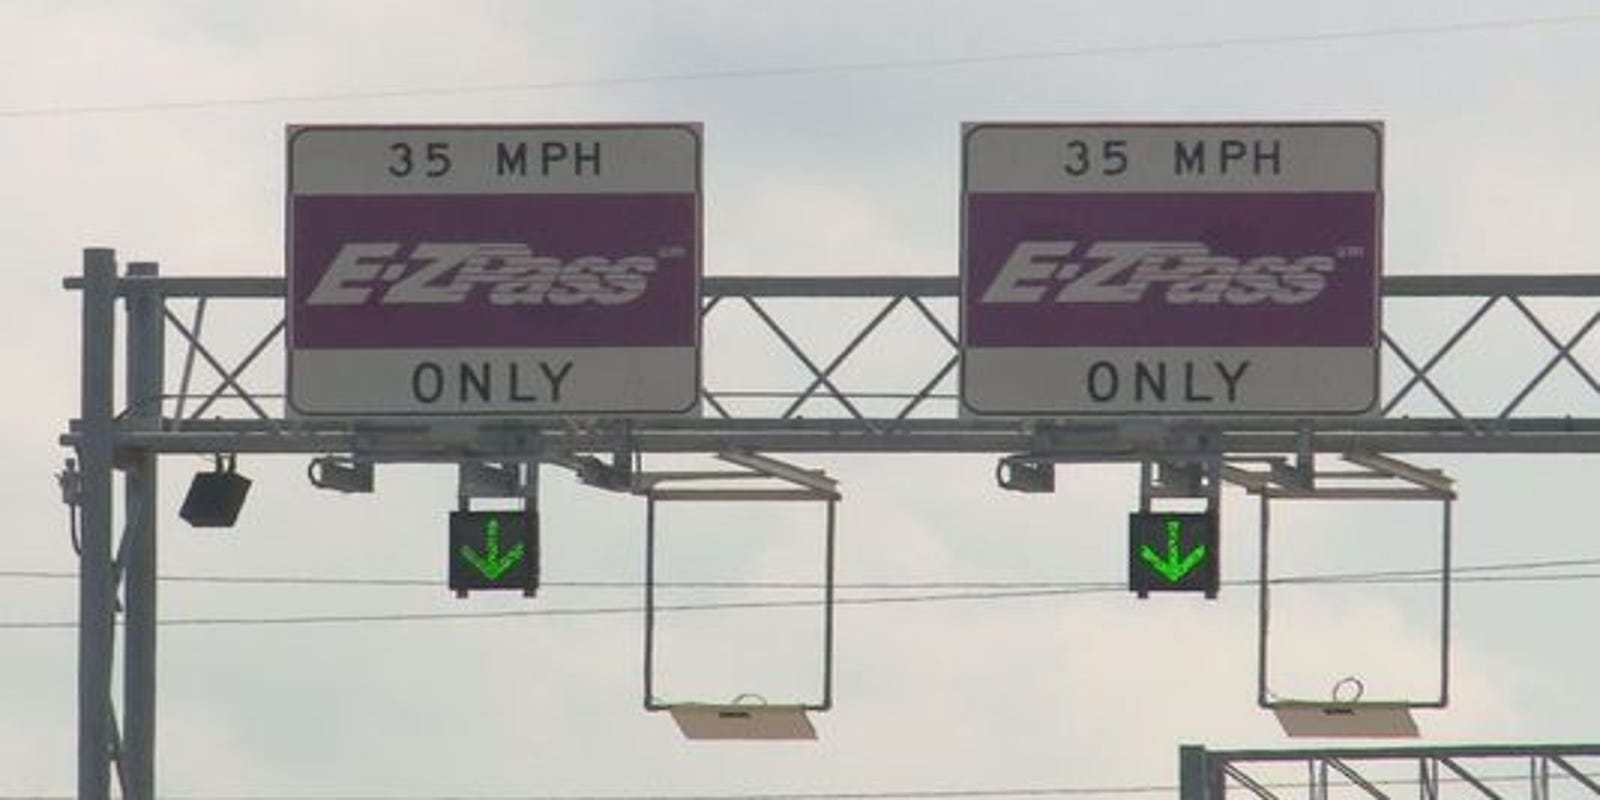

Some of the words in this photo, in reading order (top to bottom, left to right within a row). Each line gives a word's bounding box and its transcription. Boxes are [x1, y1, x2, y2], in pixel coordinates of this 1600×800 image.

[388, 142, 452, 178] 35
[496, 141, 601, 177] MPH
[1064, 139, 1128, 177] 35
[1173, 139, 1282, 176] MPH
[412, 361, 574, 404] ONLY
[1087, 360, 1251, 403] ONLY
